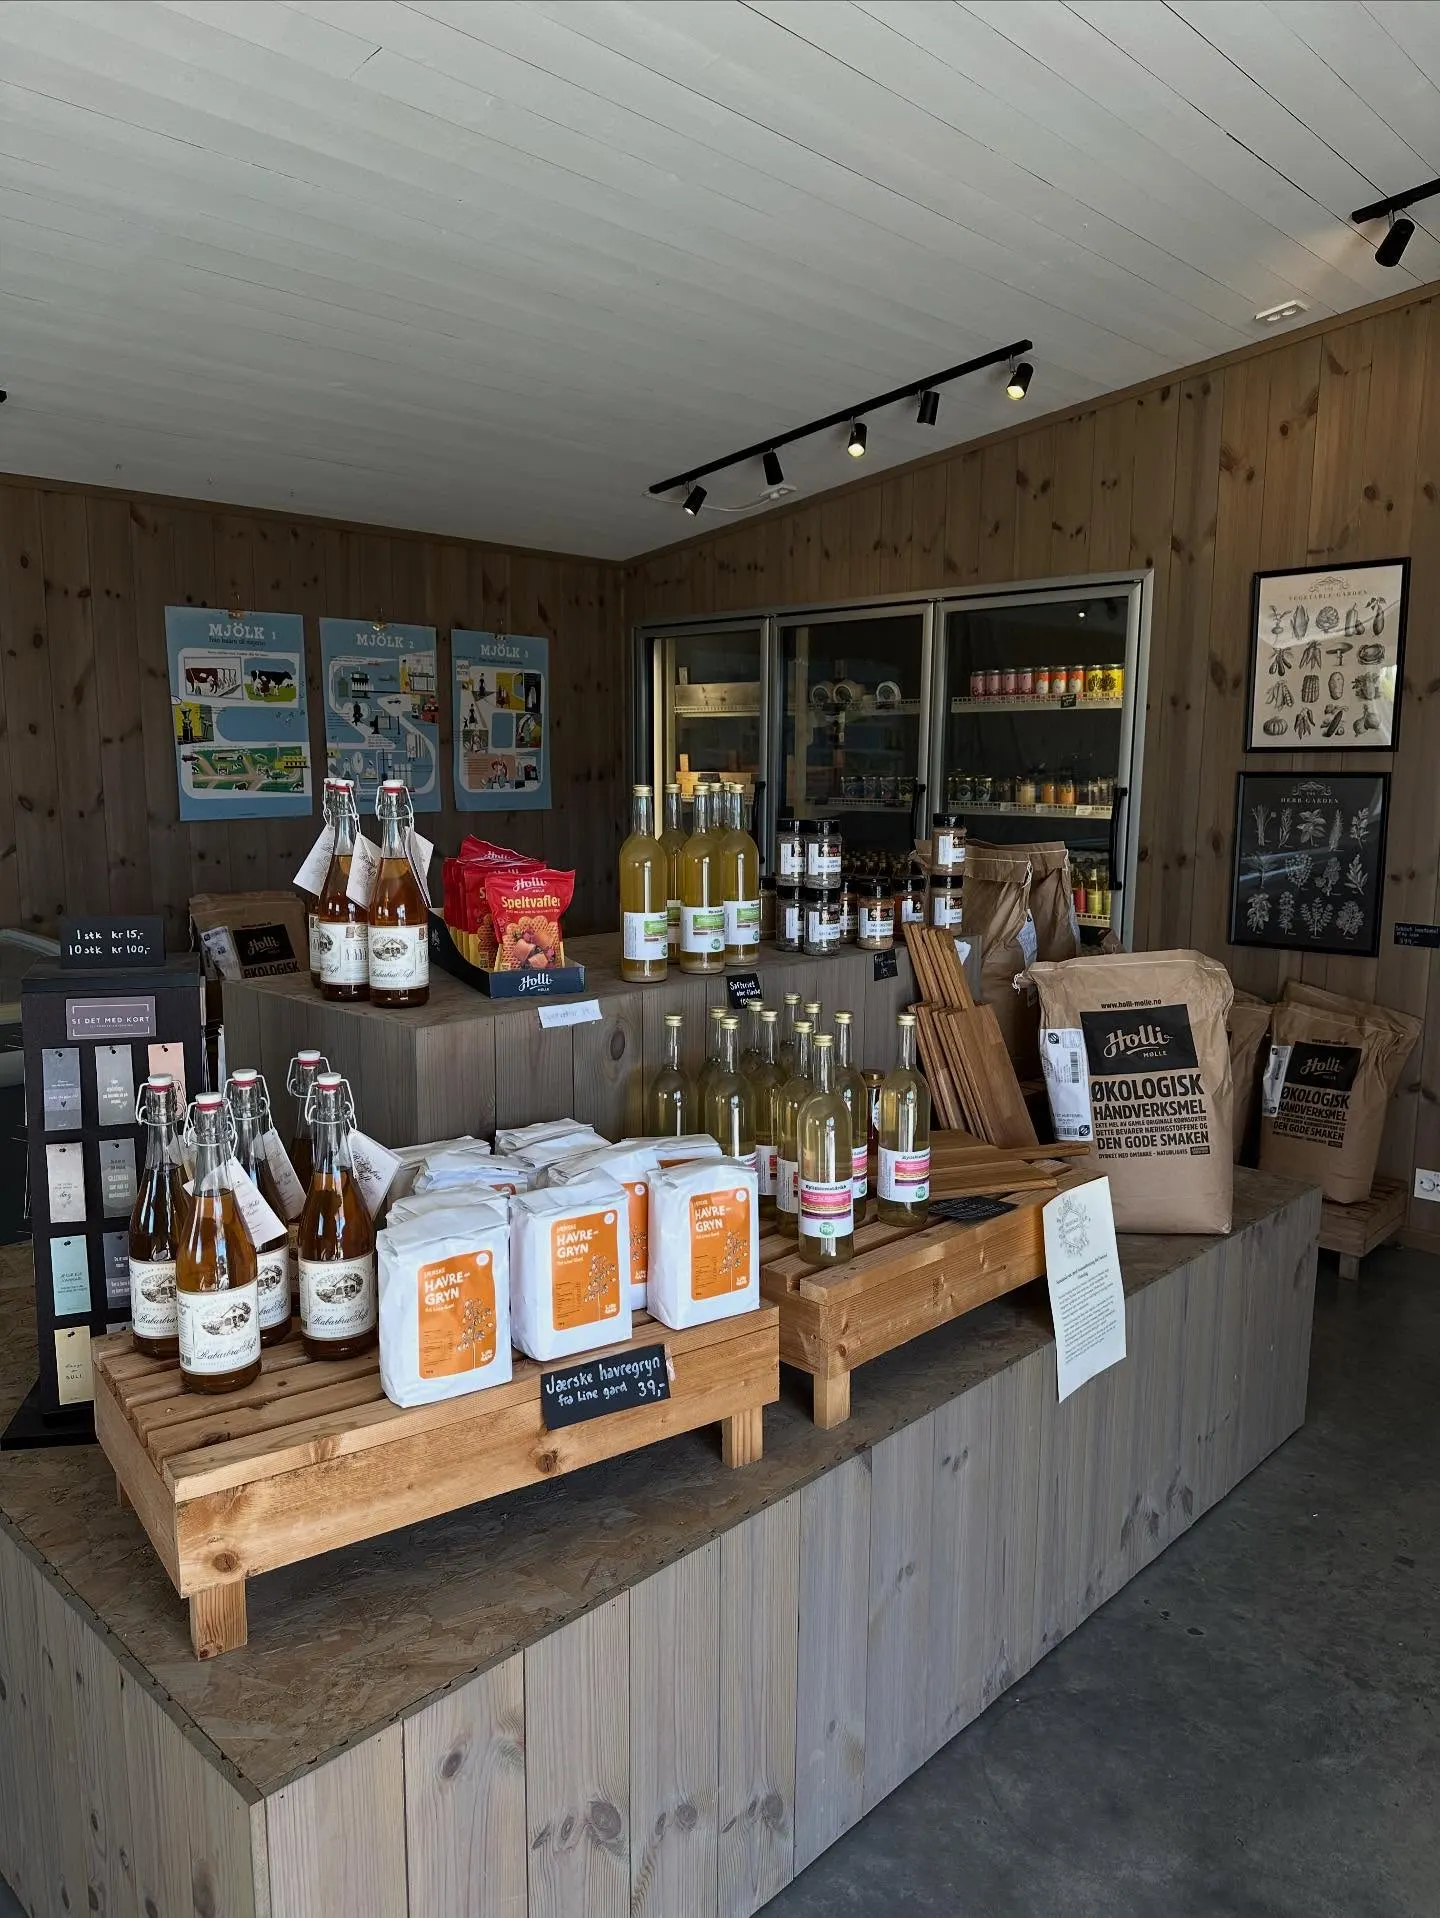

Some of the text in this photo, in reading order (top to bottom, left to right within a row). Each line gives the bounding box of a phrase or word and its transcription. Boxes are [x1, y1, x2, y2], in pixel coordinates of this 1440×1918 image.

[208, 622, 265, 640] MJÖLK
[356, 632, 404, 648] MJÖLK
[480, 643, 520, 658] MJÖLK
[513, 877, 548, 892] Holli
[77, 929, 144, 940] 1 stk kr 15,-
[69, 944, 151, 956] 10 stk kr 100,-
[248, 936, 280, 956] Holli
[518, 973, 554, 992] Holli
[1103, 1024, 1174, 1058] Holli
[1143, 1050, 1168, 1058] MØLLE
[1300, 1057, 1345, 1075] Holli
[1091, 1074, 1205, 1103] ØKOLOGISK
[1280, 1086, 1351, 1110] ØKOLOGISK
[1093, 1099, 1207, 1121] HÅNDVERKSMEL
[1278, 1100, 1348, 1122] HÅNDVERKSMEL
[1096, 1128, 1115, 1137] DETTE
[1116, 1126, 1144, 1136] BEVARER
[1199, 1122, 1208, 1130] OG
[1128, 1119, 1146, 1127] GAMLE
[1273, 1120, 1288, 1130] DEN
[1288, 1123, 1310, 1135] GODE
[1310, 1127, 1345, 1141] SMAKEN
[1097, 1131, 1209, 1150] DEN GODE SMAKEN
[694, 1205, 732, 1221] HAVRE-
[695, 1218, 724, 1233] GRYN
[556, 1228, 600, 1247] HAVRE-
[557, 1242, 589, 1259] GRYN
[424, 1271, 471, 1294] HAVRE-
[424, 1286, 460, 1306] GRYN
[309, 1313, 351, 1326] Rabarbra
[545, 1356, 660, 1395] Jærske havregryn
[557, 1379, 666, 1407] fra Line gard 39,-
